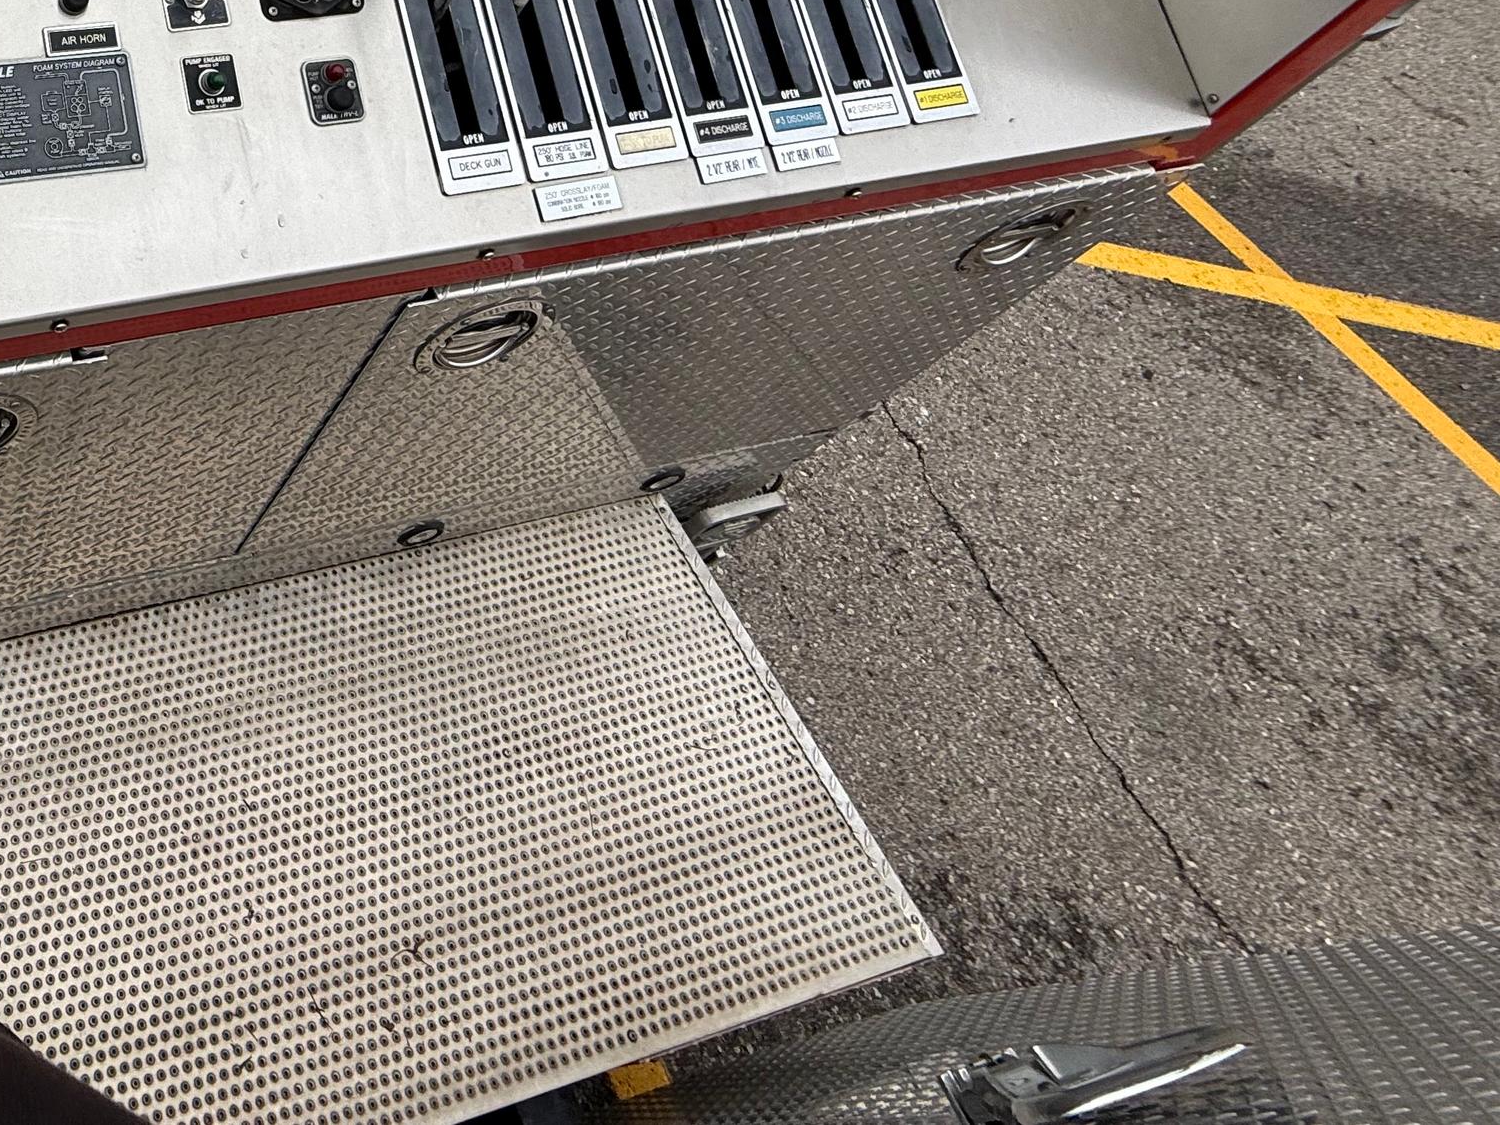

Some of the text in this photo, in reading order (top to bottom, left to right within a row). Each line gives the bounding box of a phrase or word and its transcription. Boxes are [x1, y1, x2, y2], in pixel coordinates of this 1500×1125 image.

[62, 33, 106, 45] AIR HORN
[34, 59, 114, 72] FOAM SYSTEM DIAGRAM
[185, 55, 230, 65] PUMP ENGAGED
[924, 69, 942, 79] OPEN
[852, 79, 872, 90] OPEN
[780, 89, 800, 99] OPEN
[930, 91, 964, 103] DISCHARGE
[196, 99, 205, 107] OK
[706, 101, 726, 110] OPEN
[858, 101, 894, 113] DISCHARGE
[628, 109, 650, 121] OPEN
[776, 111, 824, 125] #3 DISCHARGE
[547, 121, 568, 133] OPEN
[700, 122, 750, 136] #4 DISCHARGE
[462, 133, 484, 145] OPEN
[554, 141, 590, 153] HOSE LINE
[798, 149, 810, 161] REAR
[459, 157, 502, 172] DECK GUN
[706, 159, 740, 176] 2 REAR
[4, 169, 32, 177] CAUTION
[560, 183, 610, 197] CROSSLAY/FOAM
